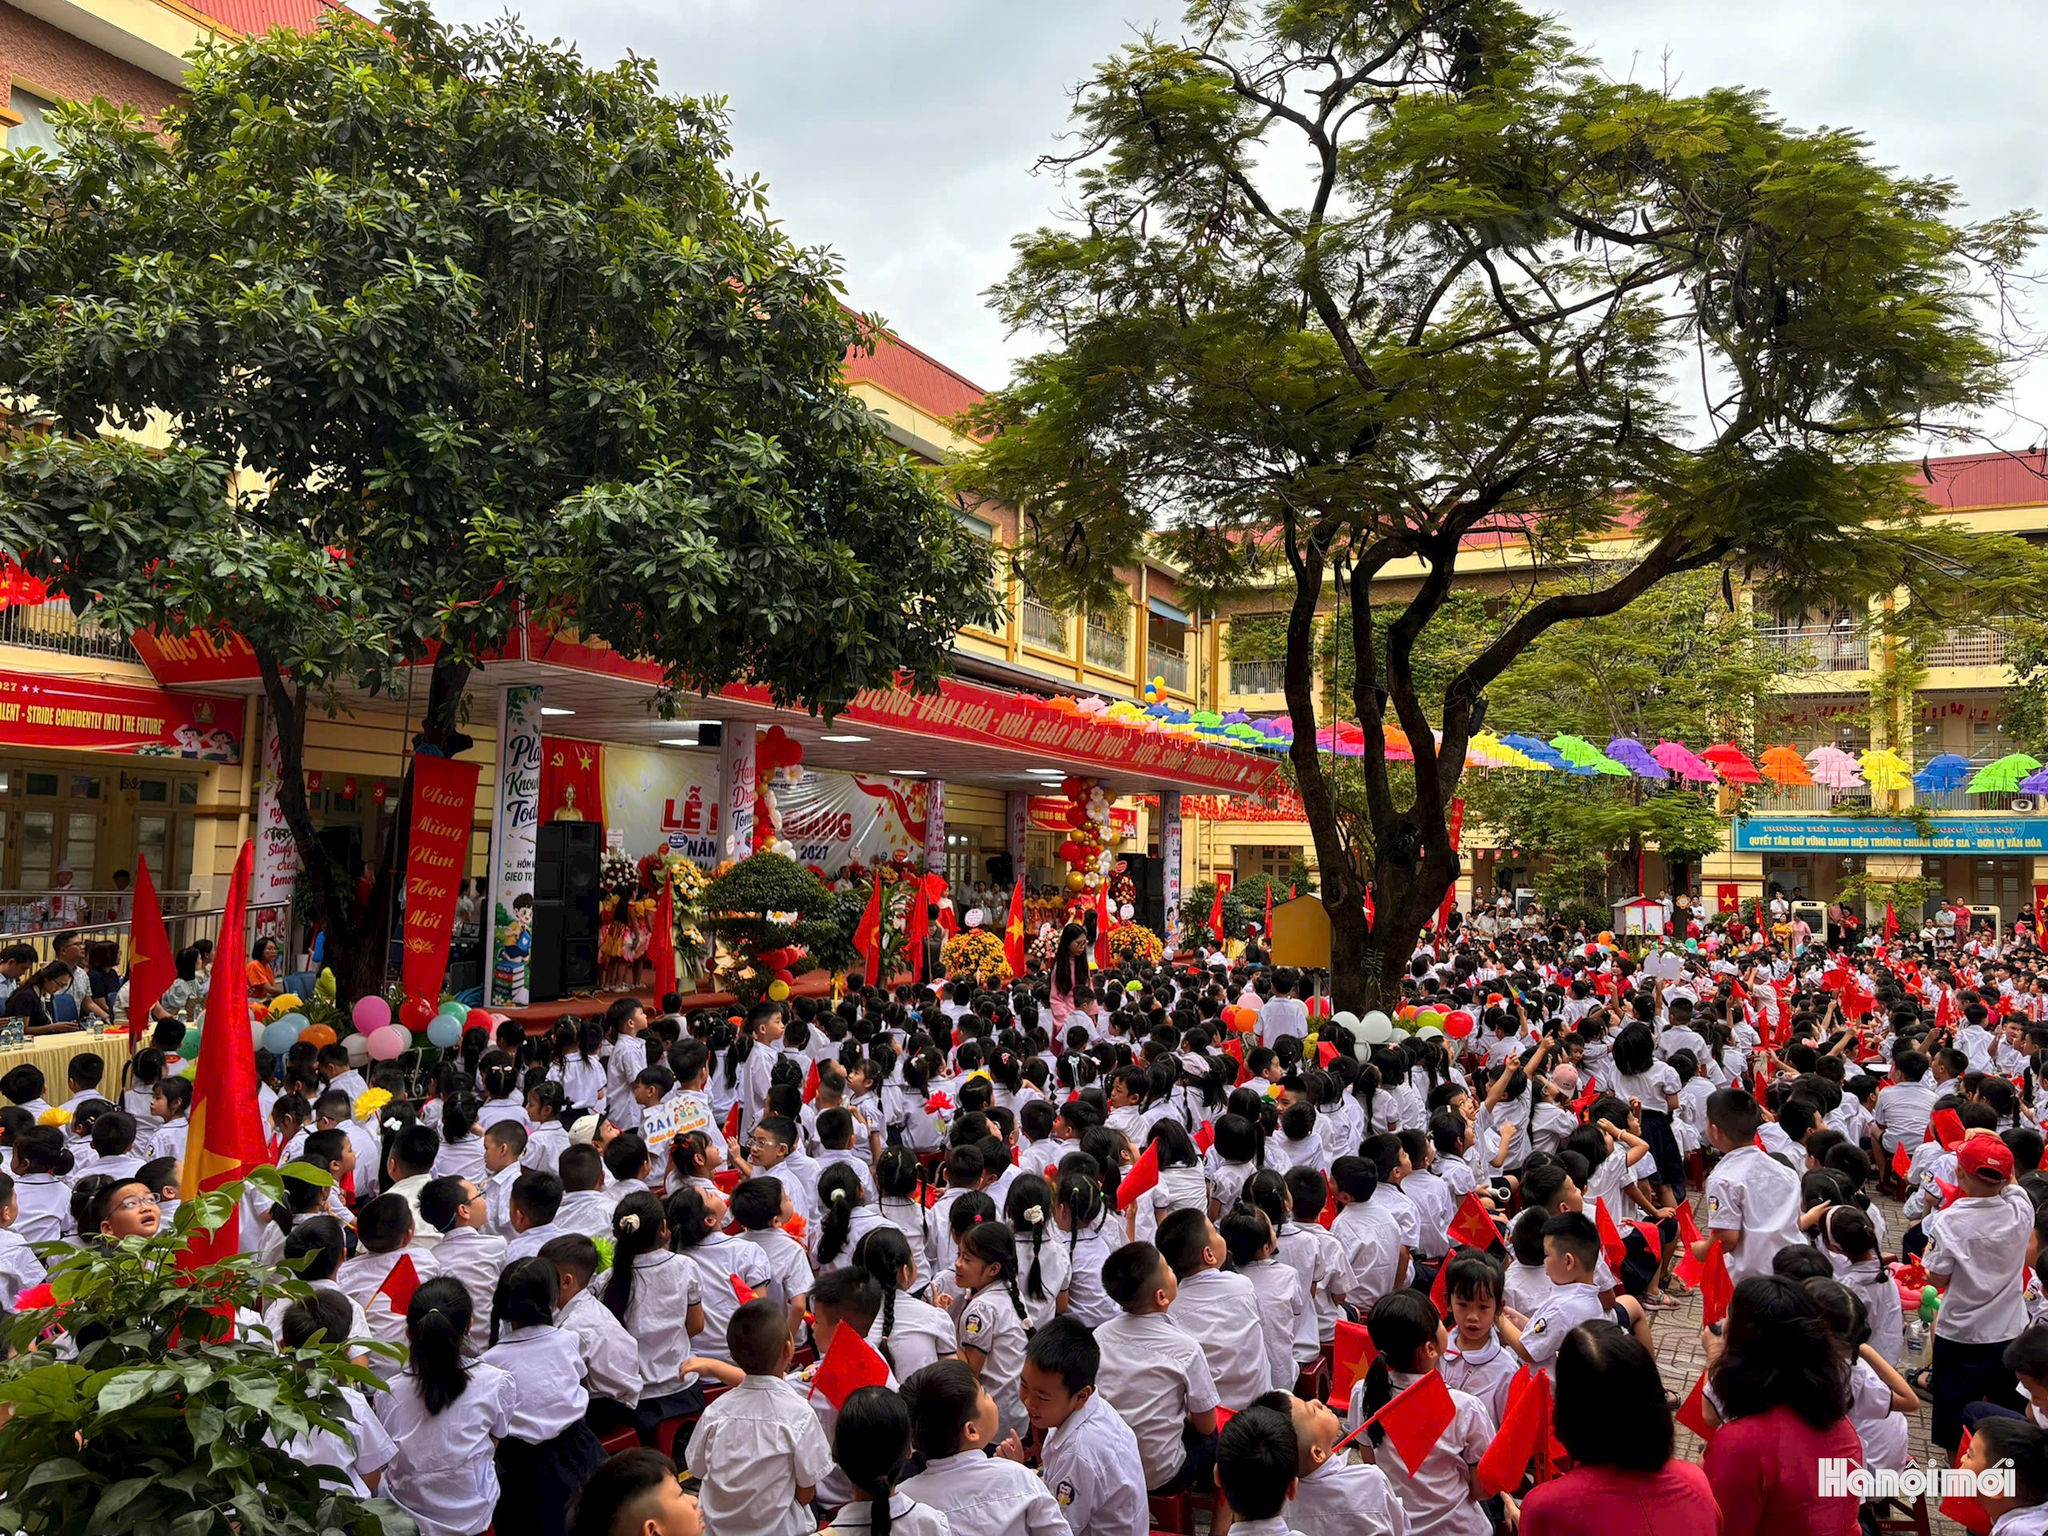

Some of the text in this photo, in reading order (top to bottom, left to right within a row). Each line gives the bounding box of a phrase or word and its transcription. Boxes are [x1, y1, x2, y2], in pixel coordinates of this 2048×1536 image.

[26, 705, 54, 726] STRIDE
[55, 708, 103, 730] CONFIDENTLY
[103, 714, 120, 732] INTO
[122, 715, 135, 733] THE
[917, 691, 958, 725] VĂN
[955, 701, 994, 732] HÓA
[996, 711, 1035, 740] NHÀ
[509, 734, 540, 770] Pla
[422, 785, 464, 808] Chào
[506, 799, 538, 828] Tod
[662, 786, 702, 832] LỄ
[414, 816, 464, 842] Mừng
[1749, 834, 1772, 846] QUYẾT
[1774, 836, 1790, 846] TÂM
[1828, 837, 1849, 847] DANH
[1932, 836, 1954, 848] QUỐC
[1956, 838, 1970, 848] GIA
[2025, 835, 2042, 848] HÓA
[1833, 826, 1855, 834] HỌC
[410, 845, 455, 869] Năm
[800, 845, 829, 860] 2027
[409, 877, 447, 901] Học
[505, 872, 523, 882] GIEO
[408, 909, 442, 929] Mới
